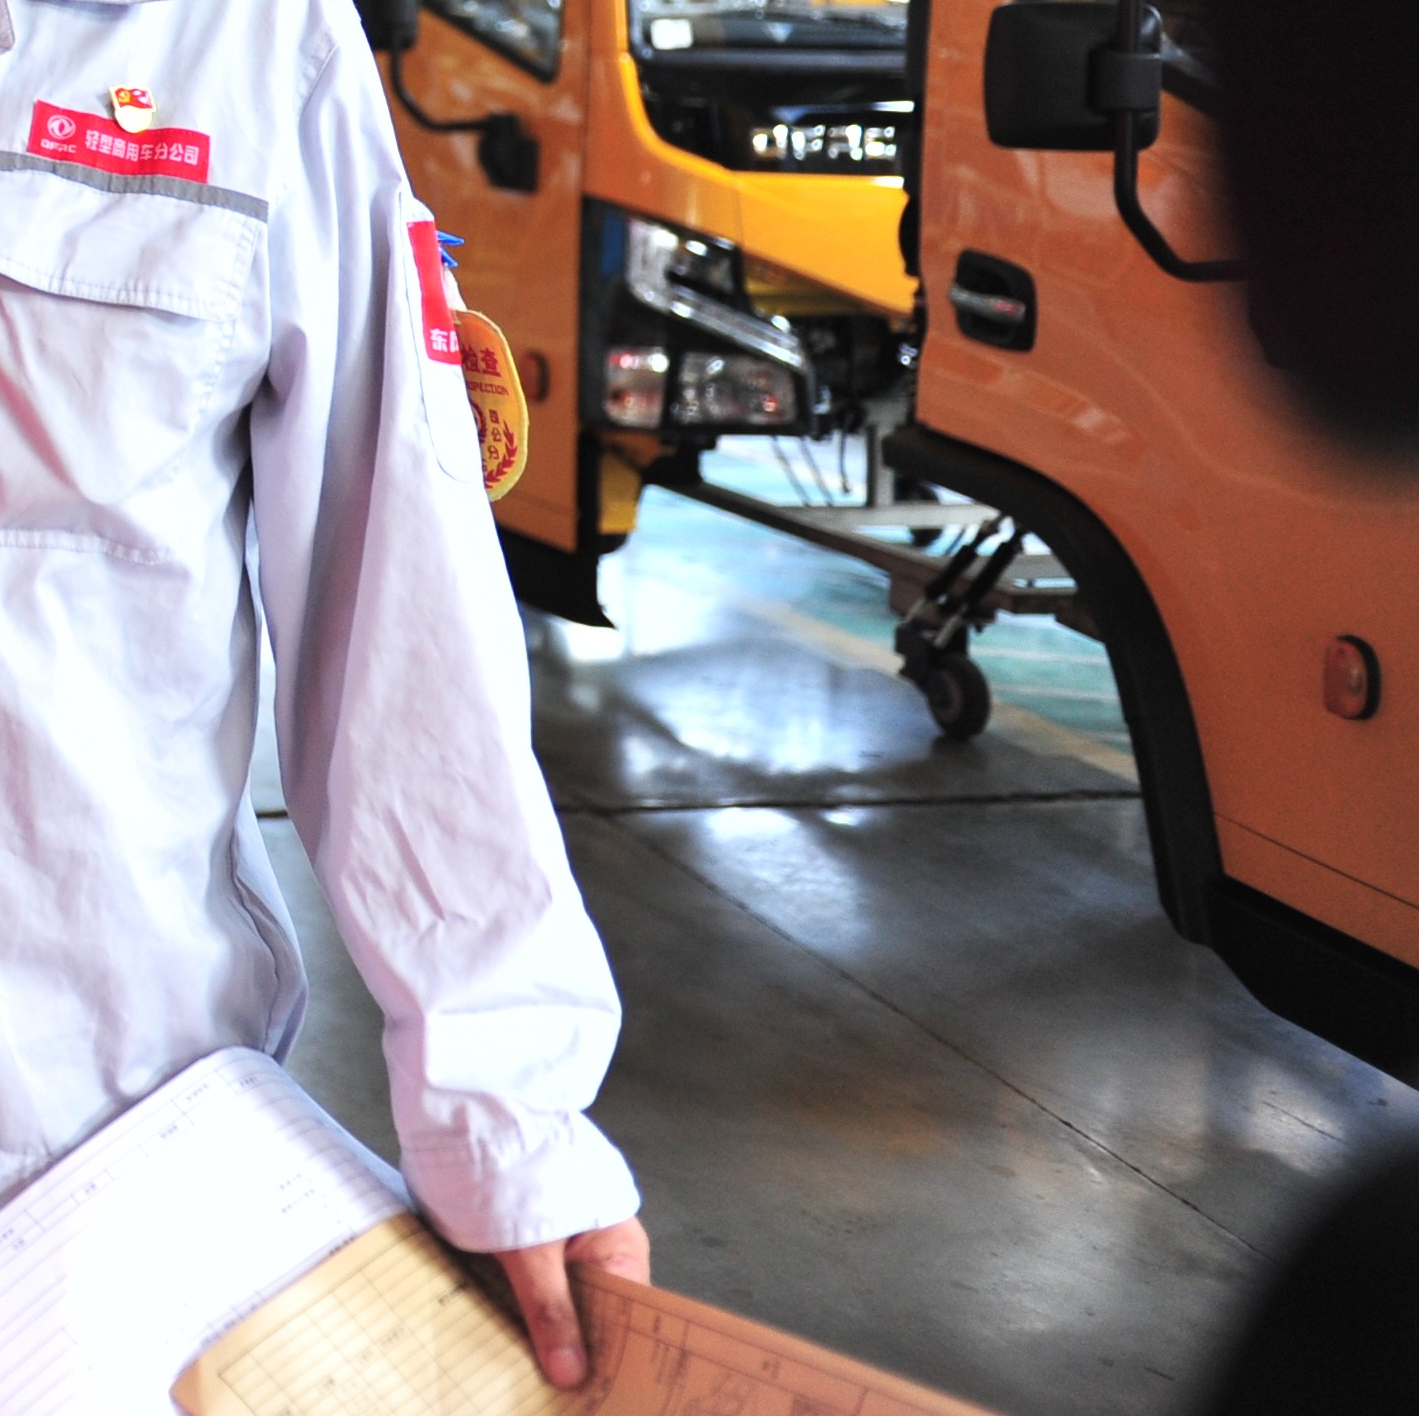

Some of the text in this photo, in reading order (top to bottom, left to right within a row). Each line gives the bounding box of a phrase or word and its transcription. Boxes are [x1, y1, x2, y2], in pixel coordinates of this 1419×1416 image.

[86, 130, 199, 165] 轻型商用车分公司
